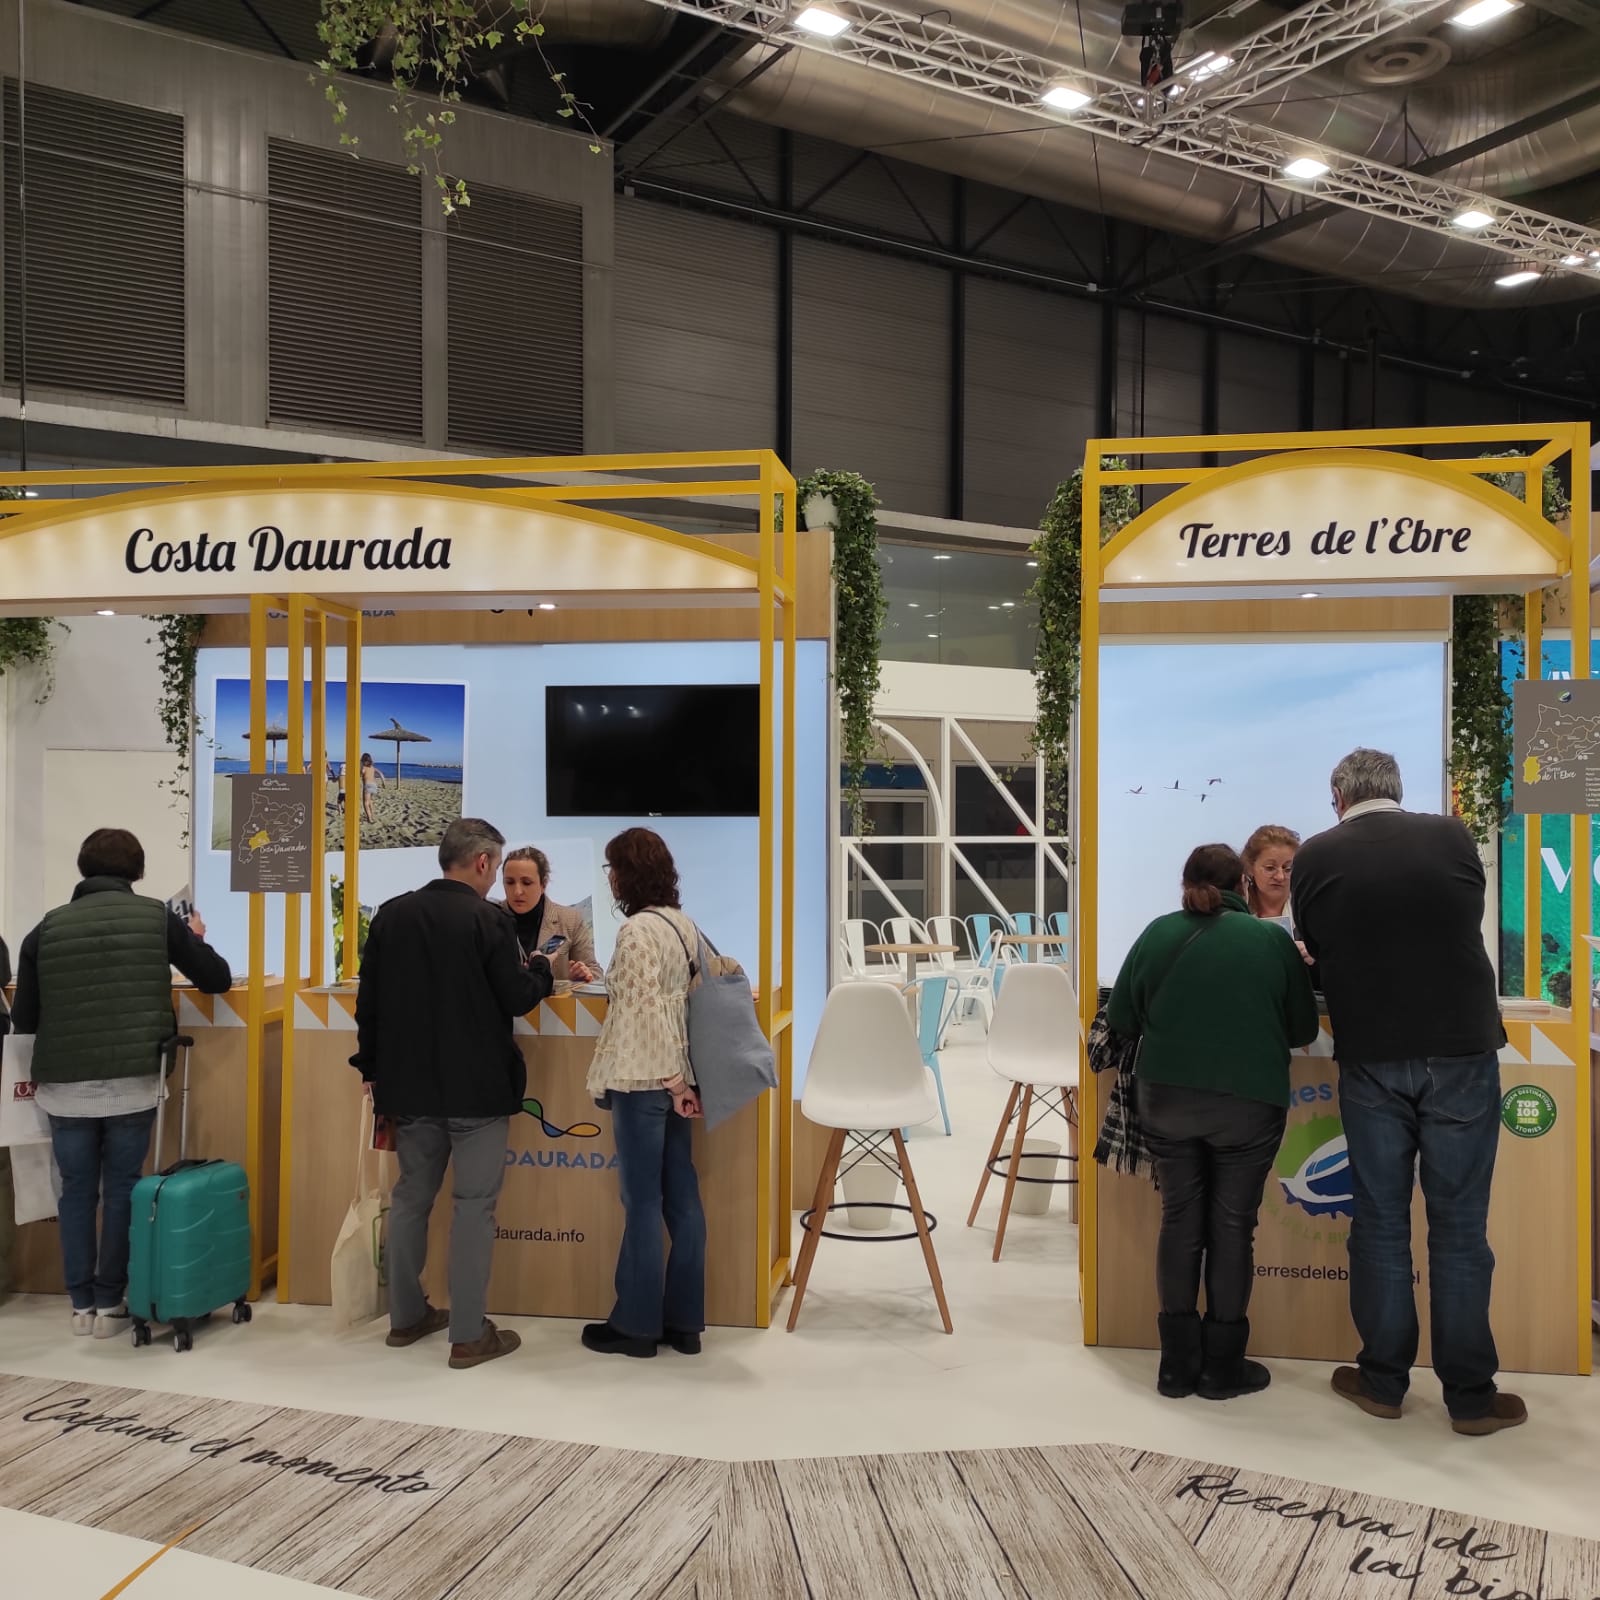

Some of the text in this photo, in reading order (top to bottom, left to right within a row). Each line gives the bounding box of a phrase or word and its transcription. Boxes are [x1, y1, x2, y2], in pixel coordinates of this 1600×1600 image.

[125, 526, 452, 573] Costa Daurada
[1179, 517, 1472, 558] Terres de l'Ebre
[1516, 1100, 1540, 1108] TOP
[1516, 1107, 1540, 1117] 100
[1515, 1125, 1542, 1133] STORIES
[22, 1398, 440, 1494] Captura el momento
[1176, 1474, 1519, 1561] Reserva de
[1349, 1546, 1424, 1580] la
